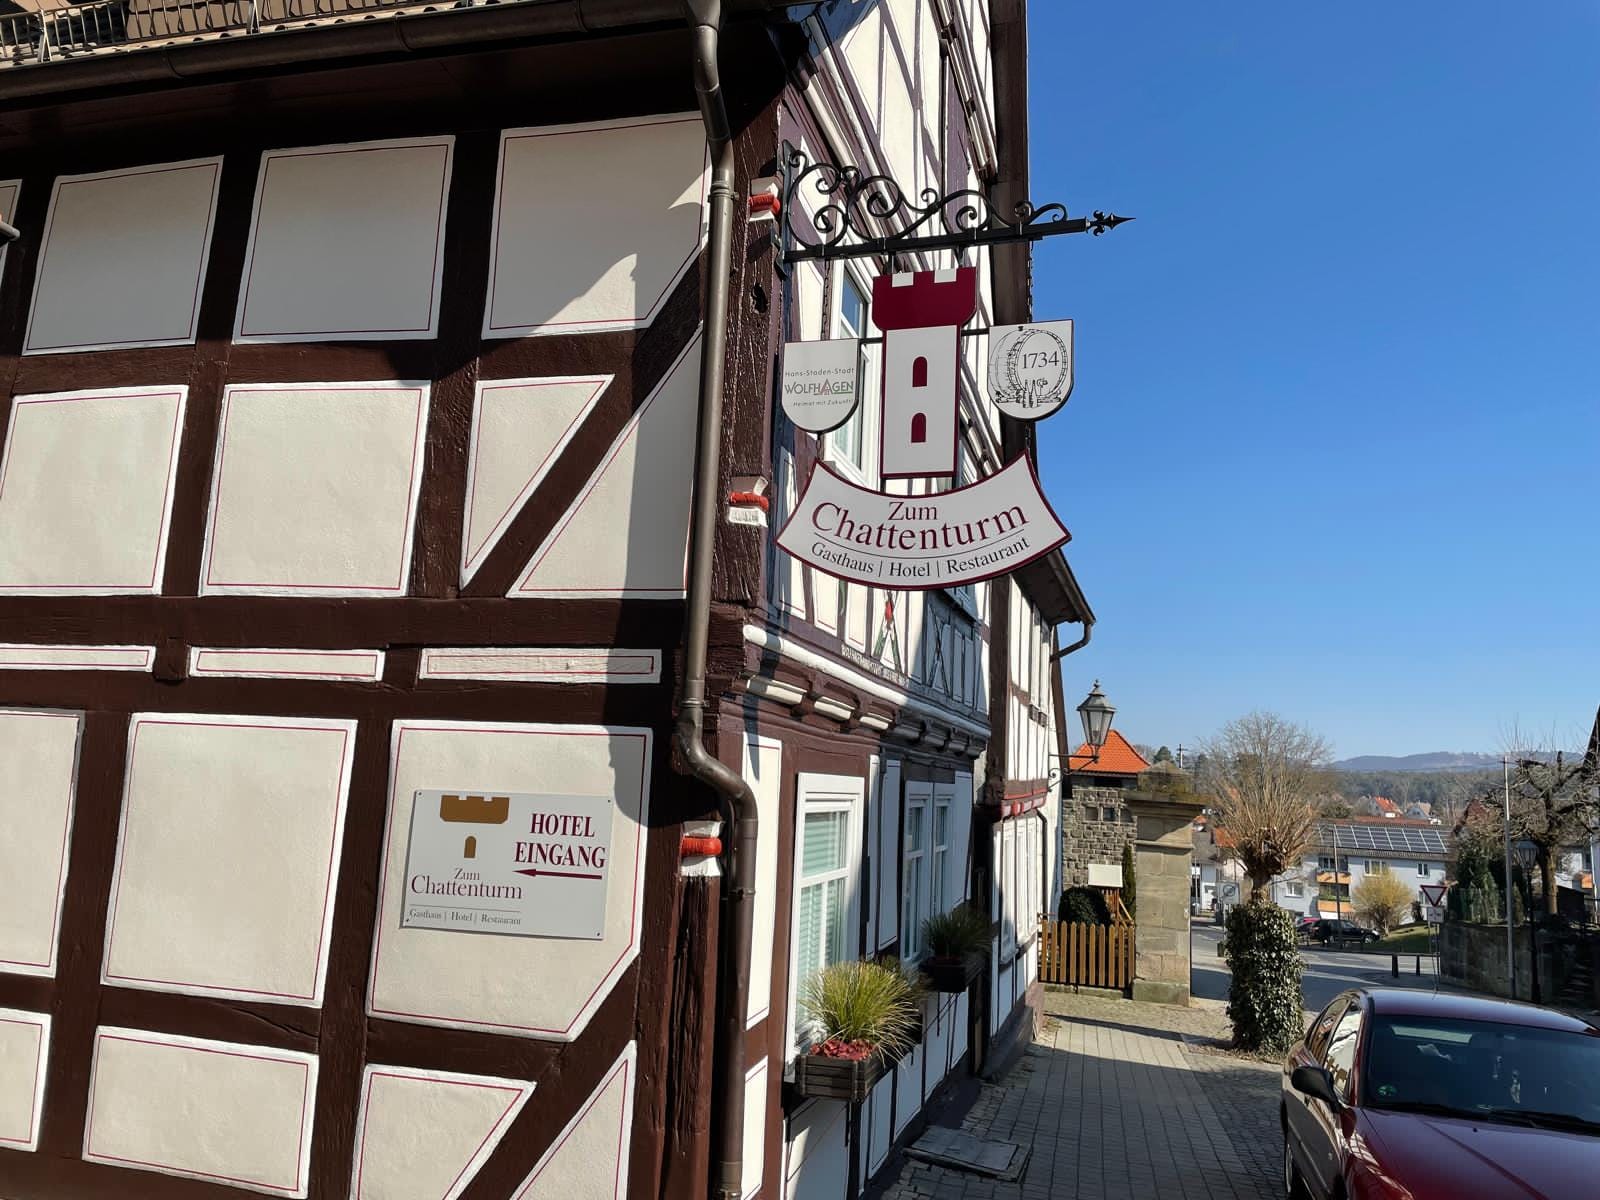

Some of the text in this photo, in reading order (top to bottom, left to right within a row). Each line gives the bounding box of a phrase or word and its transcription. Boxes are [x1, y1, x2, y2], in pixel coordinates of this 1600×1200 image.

[1021, 350, 1060, 370] 1734
[785, 367, 855, 378] Hans-Staden-Stadt
[784, 379, 855, 396] WOLFHAGEN
[887, 501, 938, 521] Zum
[811, 502, 1030, 551] Chattenturm
[811, 536, 1030, 577] Gasthaus Hotel Restaurant
[529, 813, 596, 838] HOTEL
[514, 841, 608, 869] EINGANG
[453, 867, 481, 881] Zum
[411, 874, 523, 900] Chattenturm
[409, 908, 521, 926] Gasthaus Hotel Restaurant
